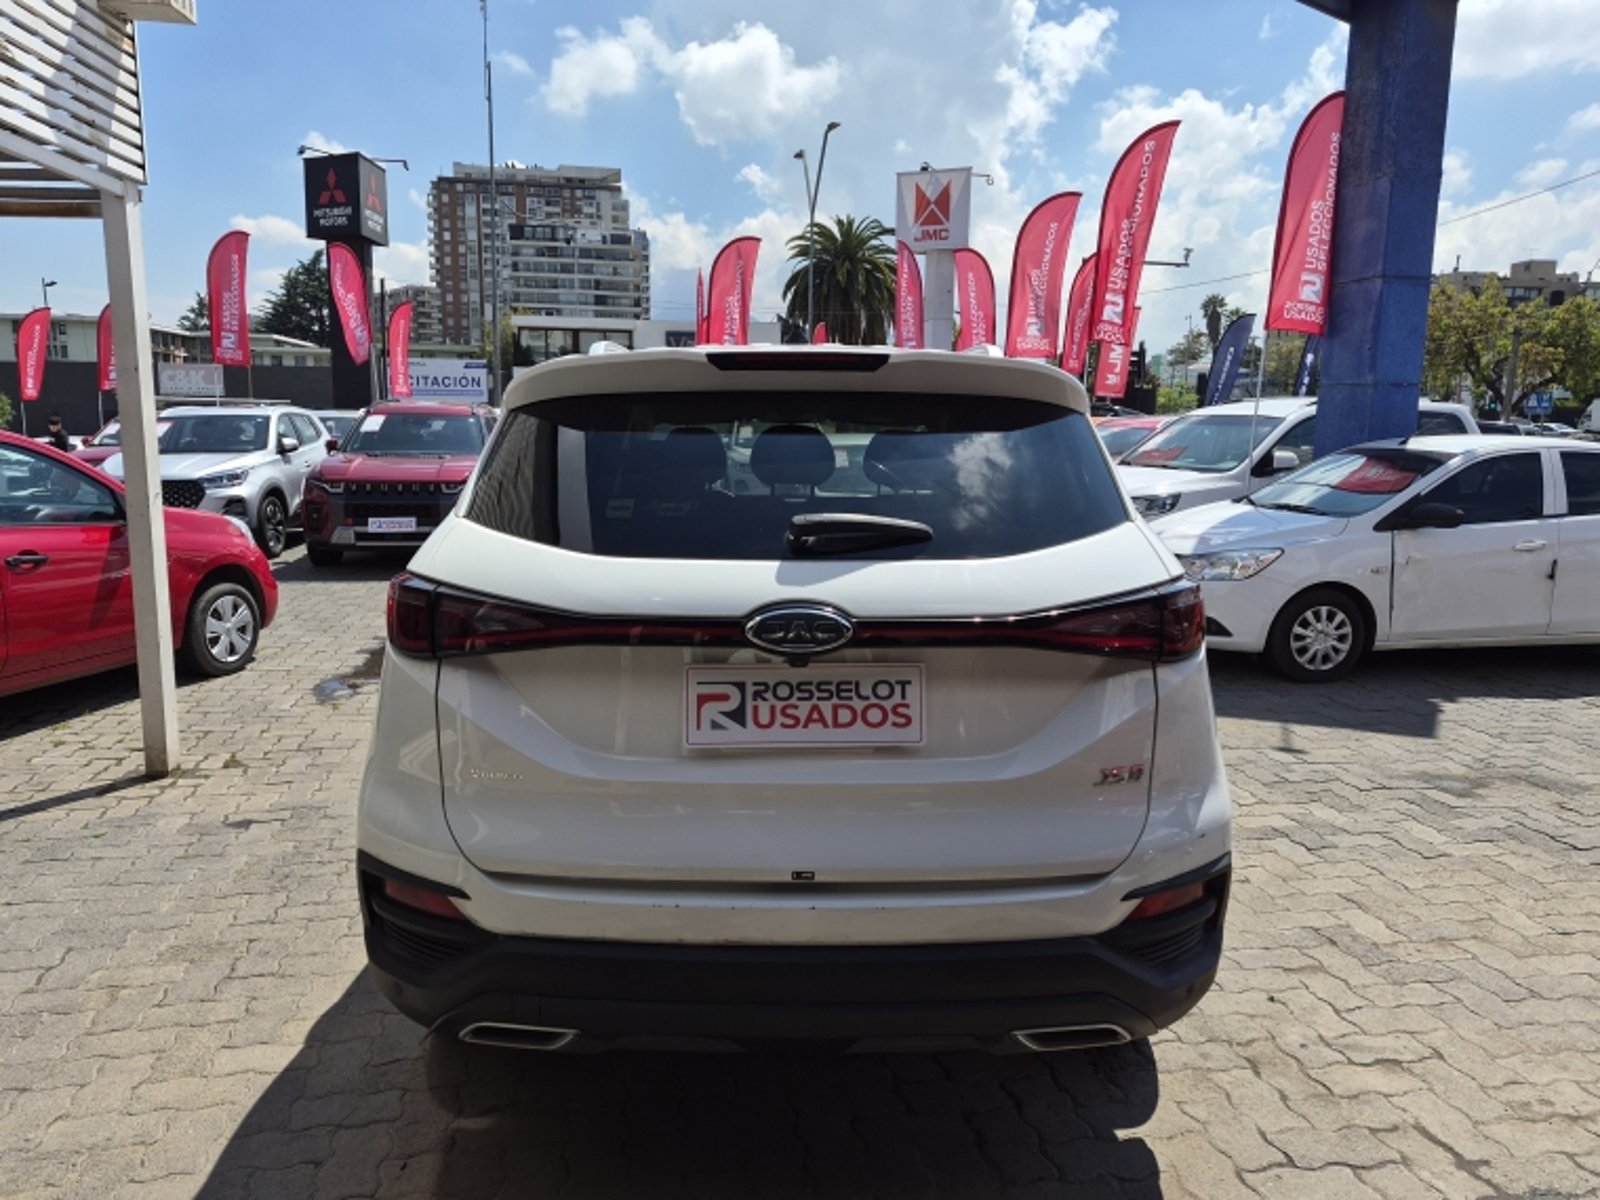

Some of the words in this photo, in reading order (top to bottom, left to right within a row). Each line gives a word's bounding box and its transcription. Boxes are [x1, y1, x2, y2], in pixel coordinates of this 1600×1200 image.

[313, 206, 352, 218] MITSUBISHI
[1316, 131, 1341, 272] SELECCIONADOS
[319, 216, 348, 227] MOTORS
[913, 229, 949, 242] JMC
[1305, 200, 1325, 269] USADOS
[1108, 218, 1131, 289] USADOS
[1108, 344, 1124, 374] JM
[408, 373, 482, 388] CITACIÓN
[761, 620, 838, 639] JAC
[752, 680, 912, 701] ROSSELOT
[752, 703, 913, 729] USADOS
